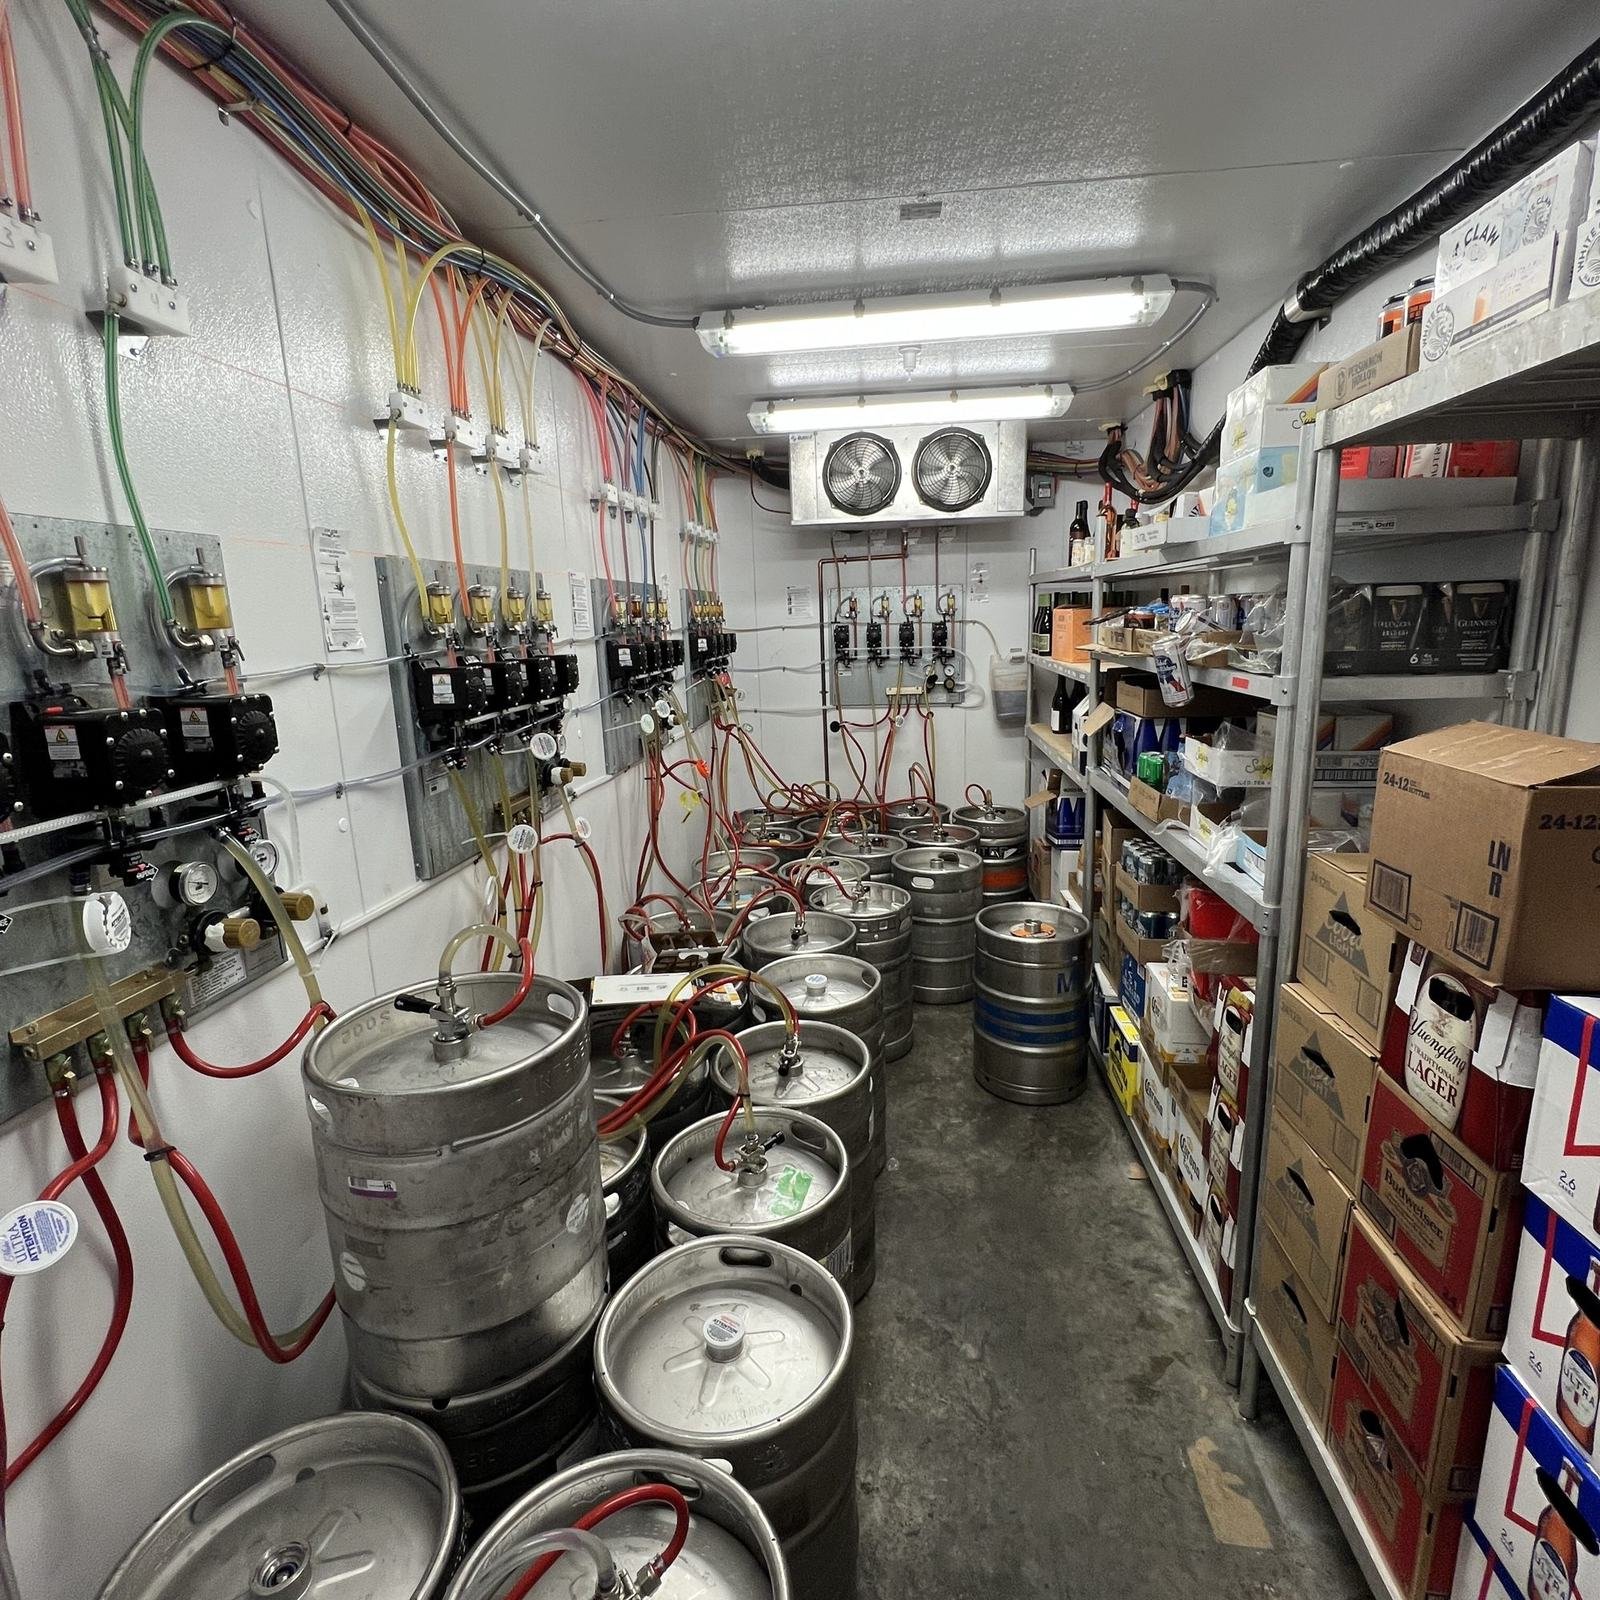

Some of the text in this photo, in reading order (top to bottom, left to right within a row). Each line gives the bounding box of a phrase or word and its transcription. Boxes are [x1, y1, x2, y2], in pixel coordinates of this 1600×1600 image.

[1464, 222, 1500, 247] CLAW
[1578, 226, 1597, 273] WHITE
[1409, 653, 1419, 665] 6
[1410, 1008, 1468, 1074] Yuengling
[1407, 1049, 1458, 1108] LAGER
[1413, 1045, 1458, 1085] TRADITIONAL
[1384, 1167, 1443, 1239] Budweiser
[8, 1222, 28, 1264] ULTRA
[17, 1214, 39, 1262] ATTENTION
[1563, 1367, 1596, 1408] ULTRA
